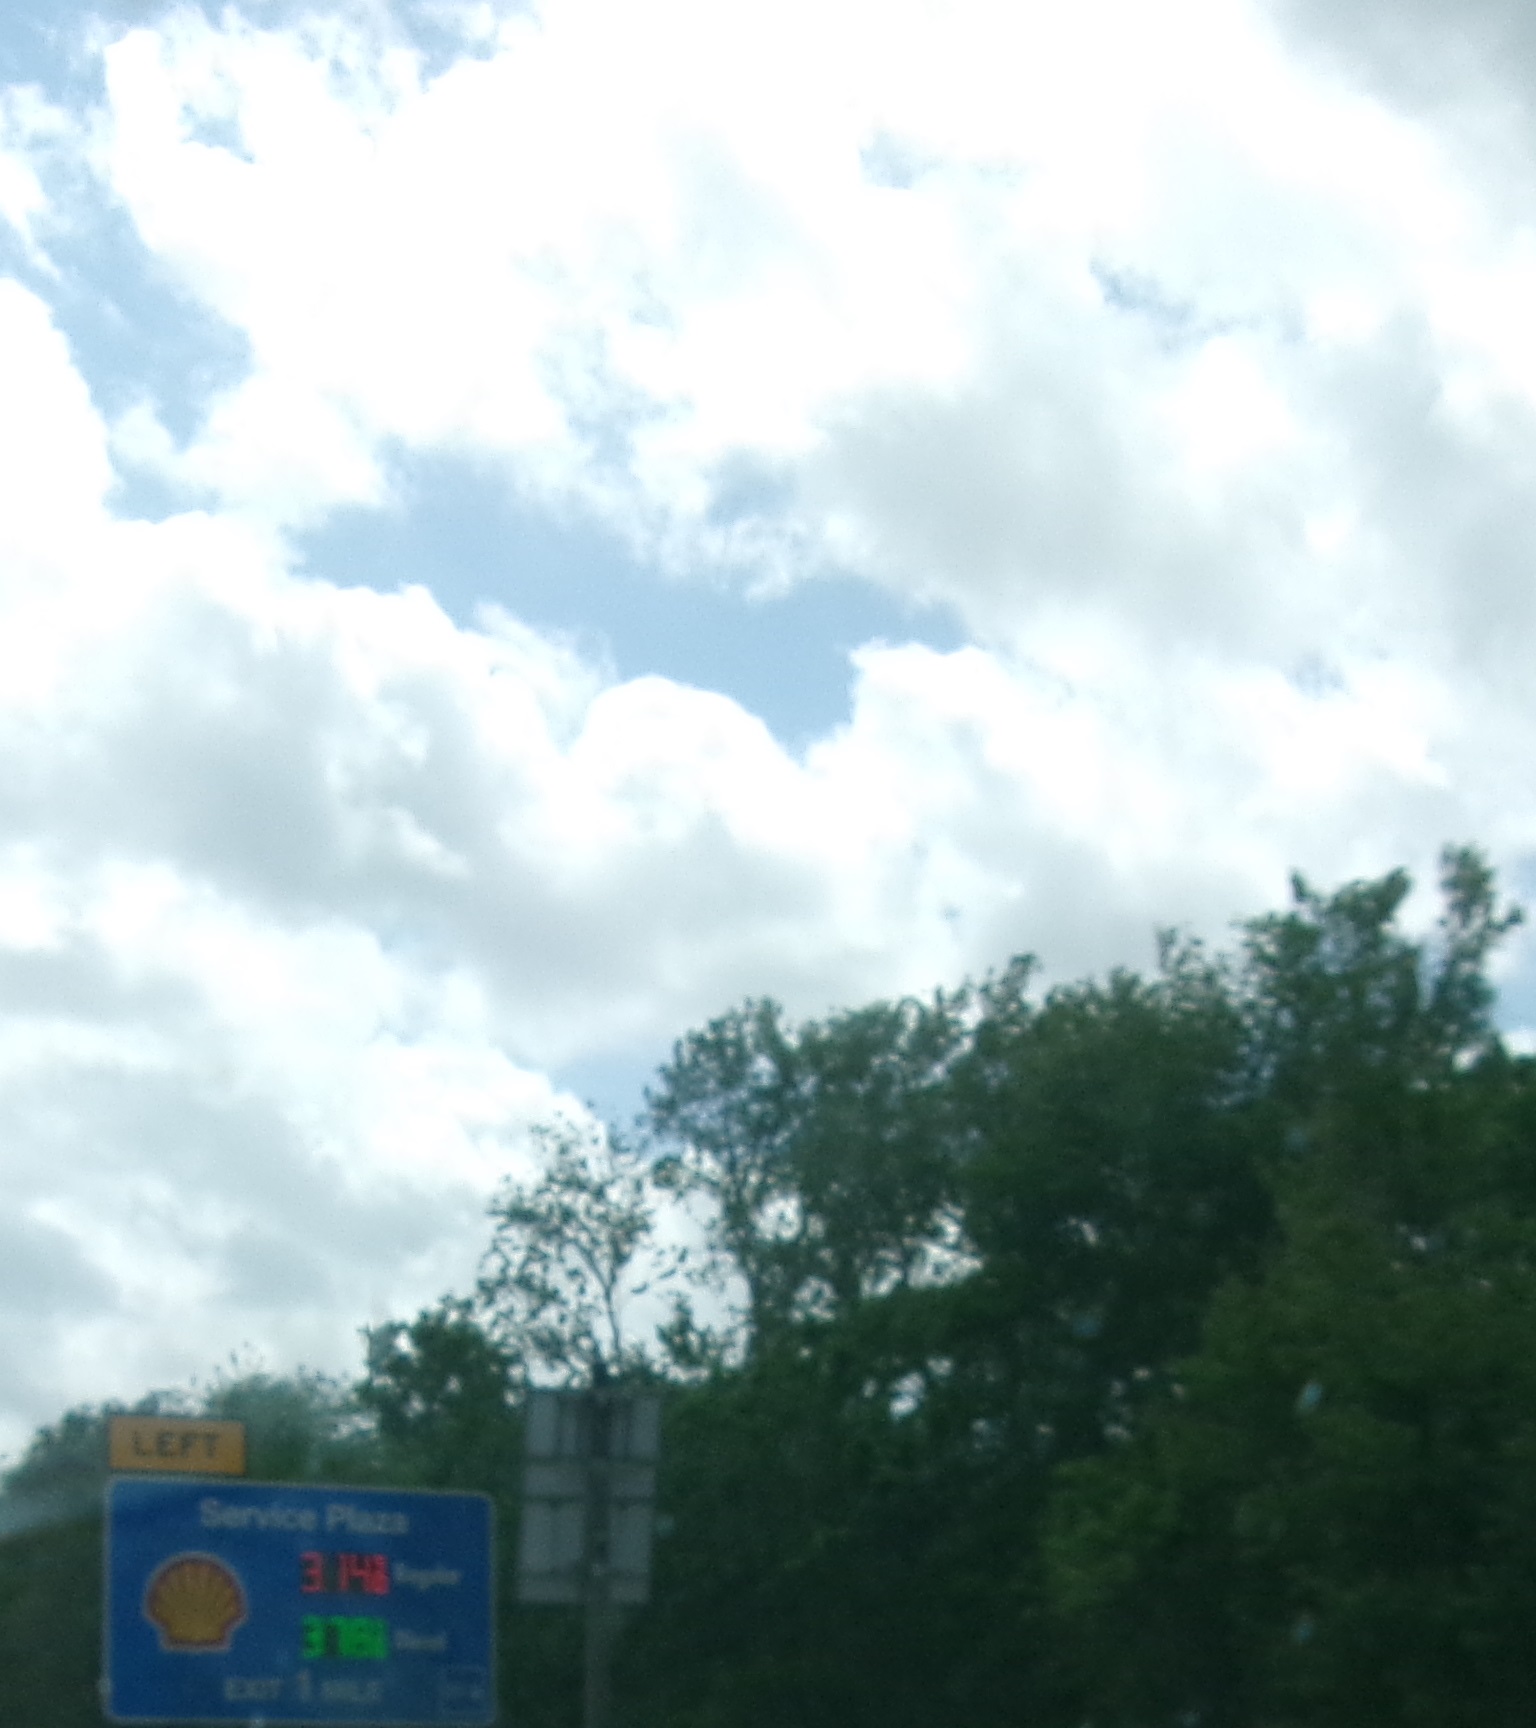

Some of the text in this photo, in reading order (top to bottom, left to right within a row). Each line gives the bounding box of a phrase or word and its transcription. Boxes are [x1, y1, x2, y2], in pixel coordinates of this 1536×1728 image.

[133, 1430, 217, 1461] LEFT
[200, 1501, 409, 1534] Service Plaza
